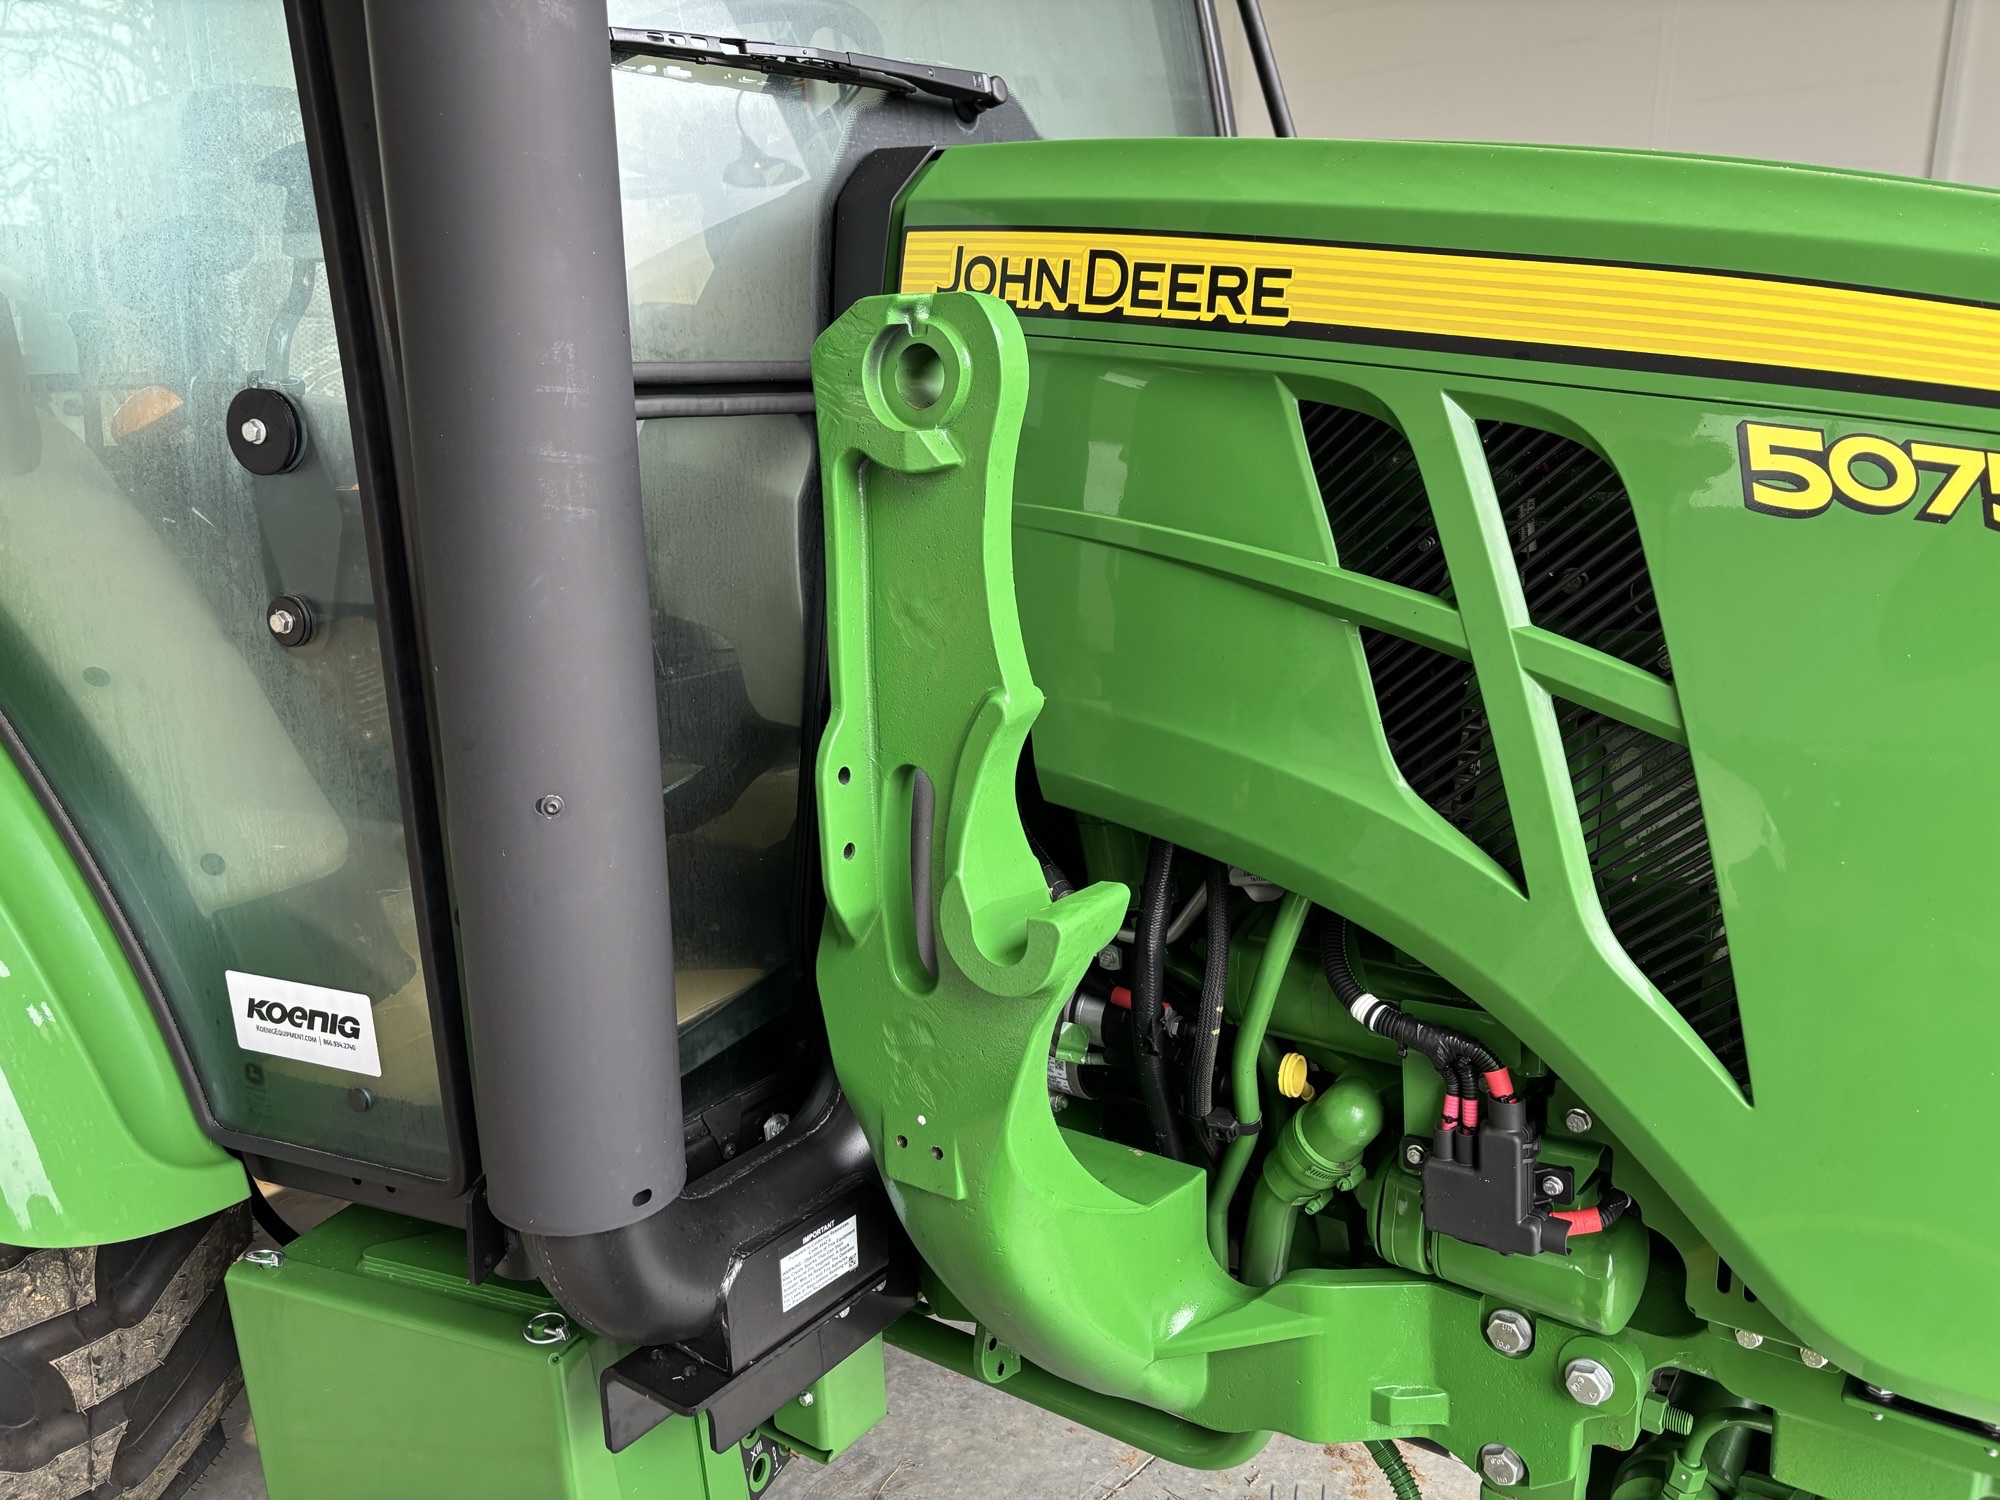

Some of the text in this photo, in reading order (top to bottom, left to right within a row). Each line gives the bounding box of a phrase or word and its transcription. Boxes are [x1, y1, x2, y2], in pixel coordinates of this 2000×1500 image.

[937, 246, 1293, 318] JOHN DEERE
[1737, 420, 2000, 531] 507
[802, 1219, 835, 1245] IMPORTANT
